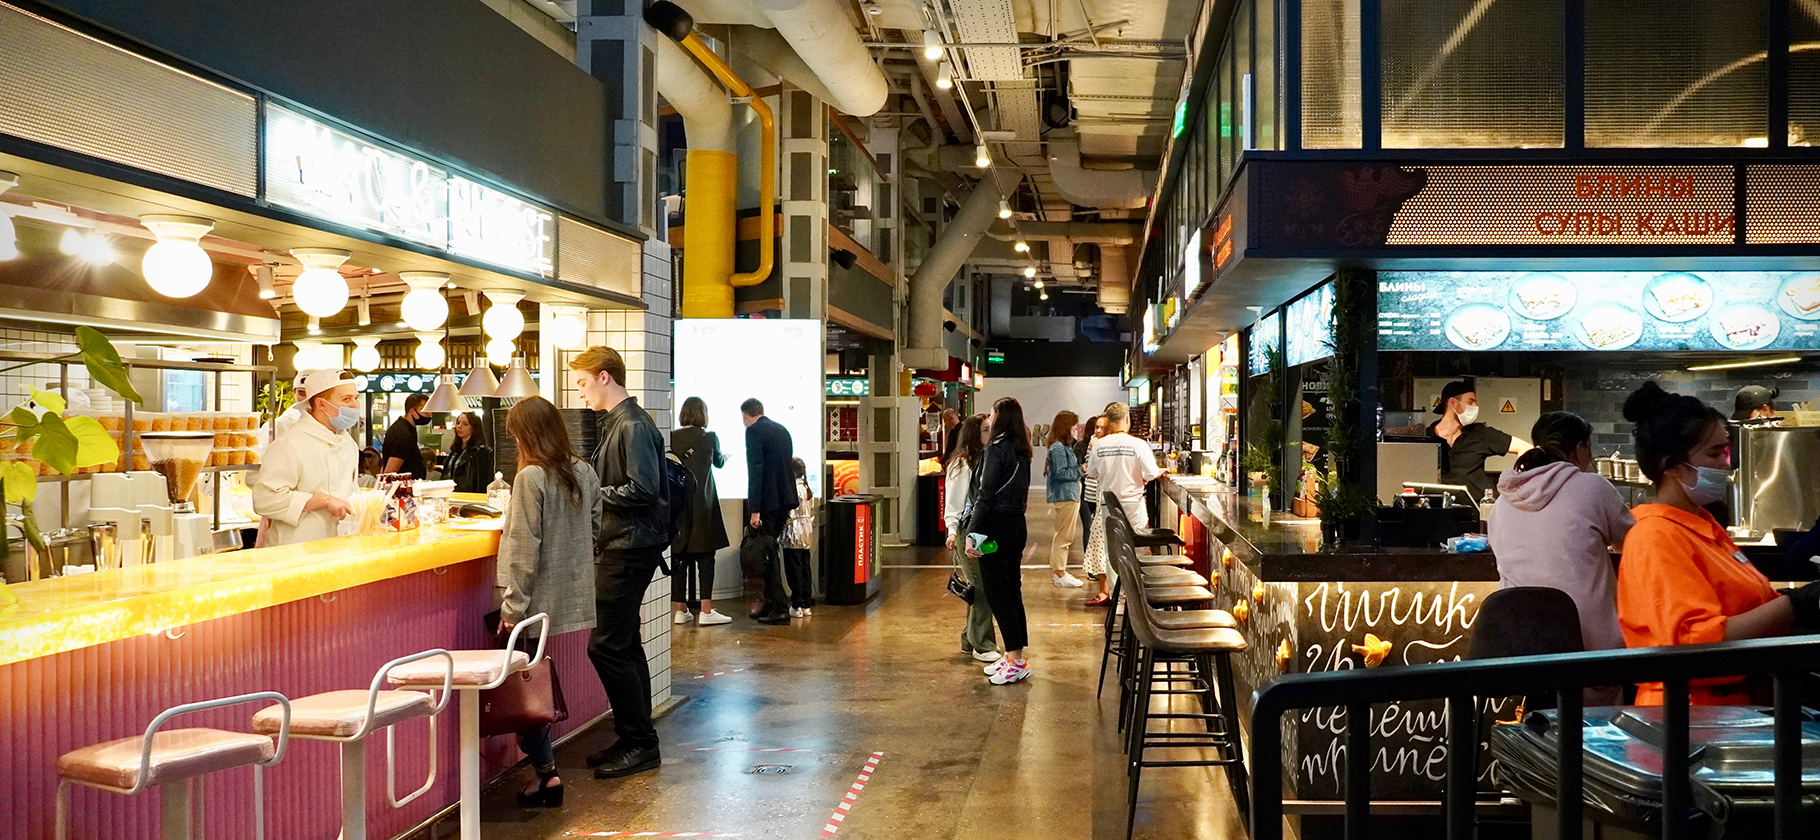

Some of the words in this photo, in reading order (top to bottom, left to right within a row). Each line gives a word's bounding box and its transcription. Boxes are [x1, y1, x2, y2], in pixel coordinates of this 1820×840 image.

[1576, 174, 1693, 199] БЛИНЫ
[1535, 212, 1621, 236] СУПЫ
[1636, 212, 1735, 236] КАШИ
[1379, 282, 1426, 293] БЛИНЫ
